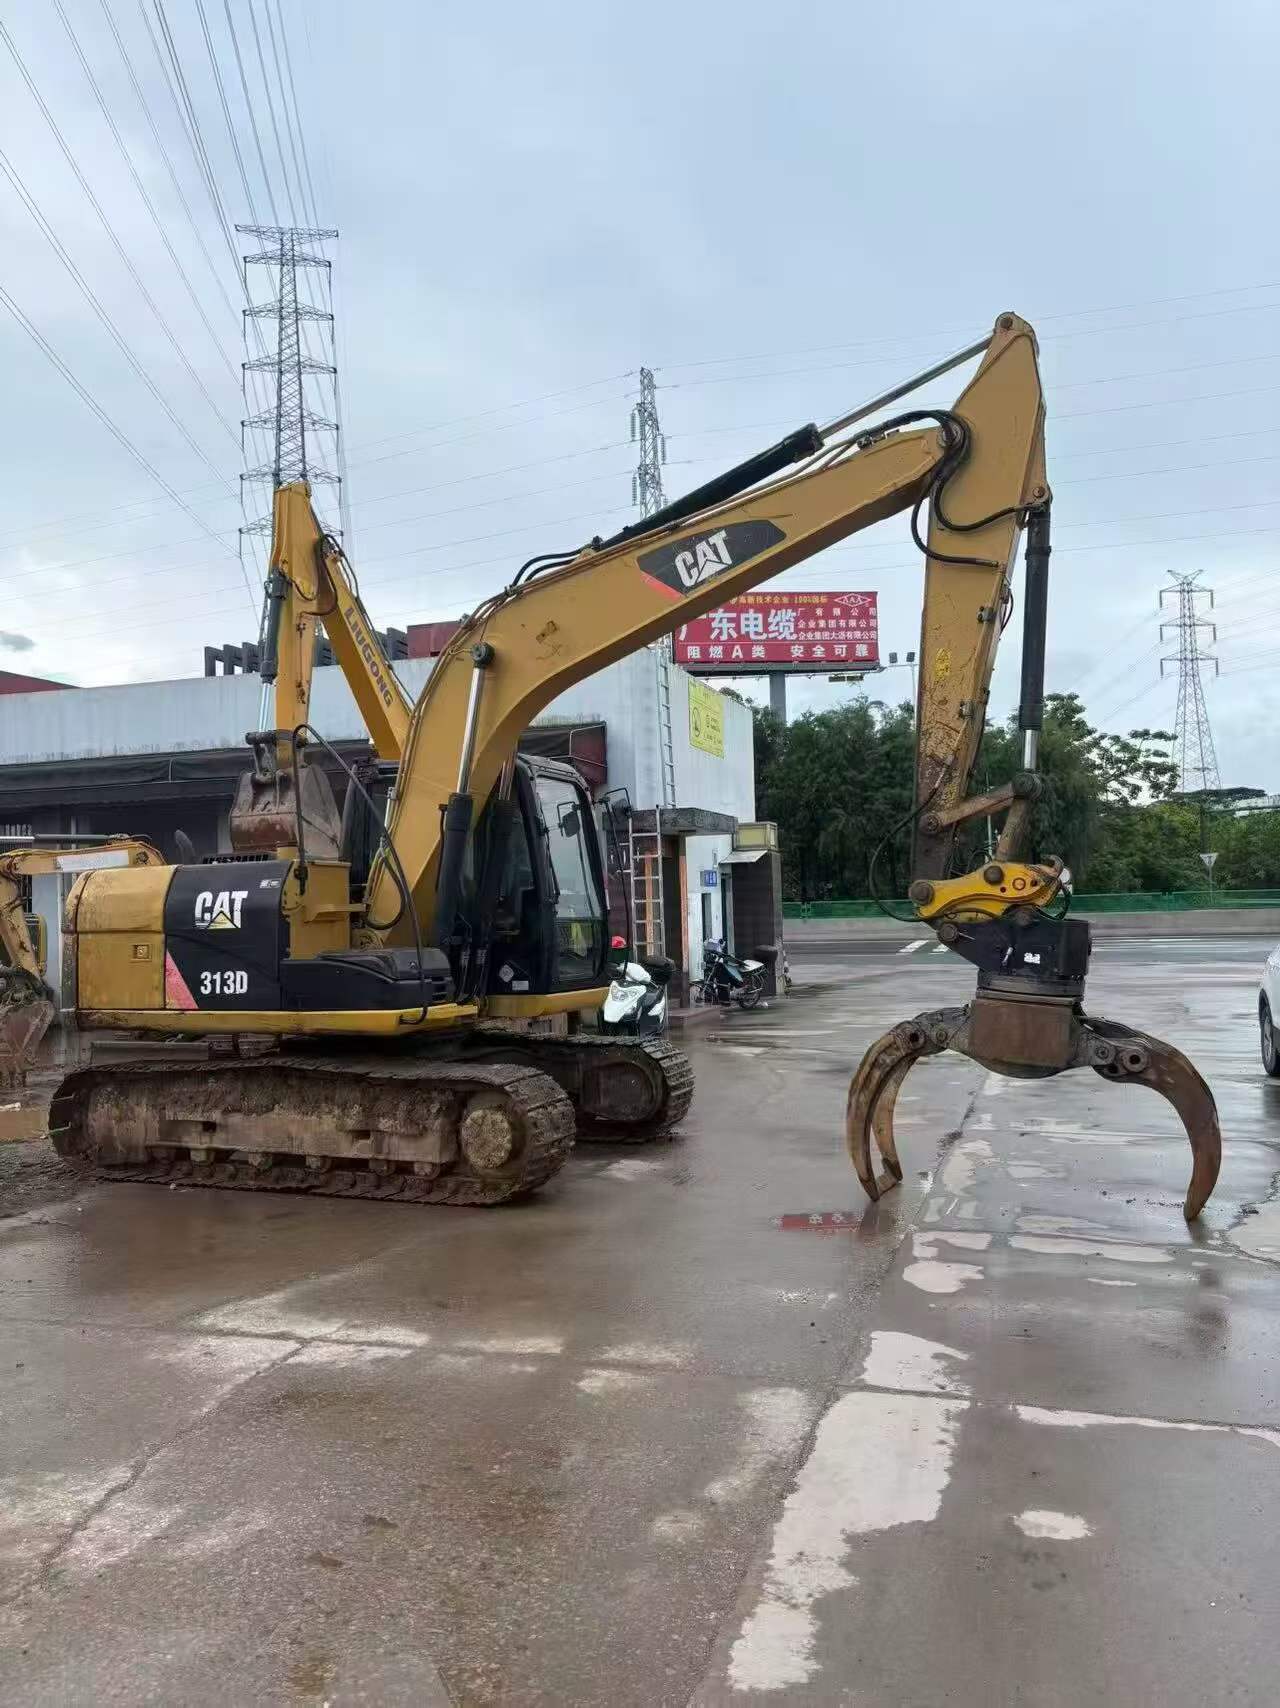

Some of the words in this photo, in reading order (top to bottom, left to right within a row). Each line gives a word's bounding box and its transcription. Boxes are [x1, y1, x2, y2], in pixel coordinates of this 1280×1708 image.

[675, 529, 732, 587] CAT
[344, 607, 394, 708] LIUGONG
[687, 645, 766, 659] 阻燃A类
[790, 643, 869, 657] 安全可靠
[195, 891, 248, 929] CAT
[200, 971, 248, 994] 313D
